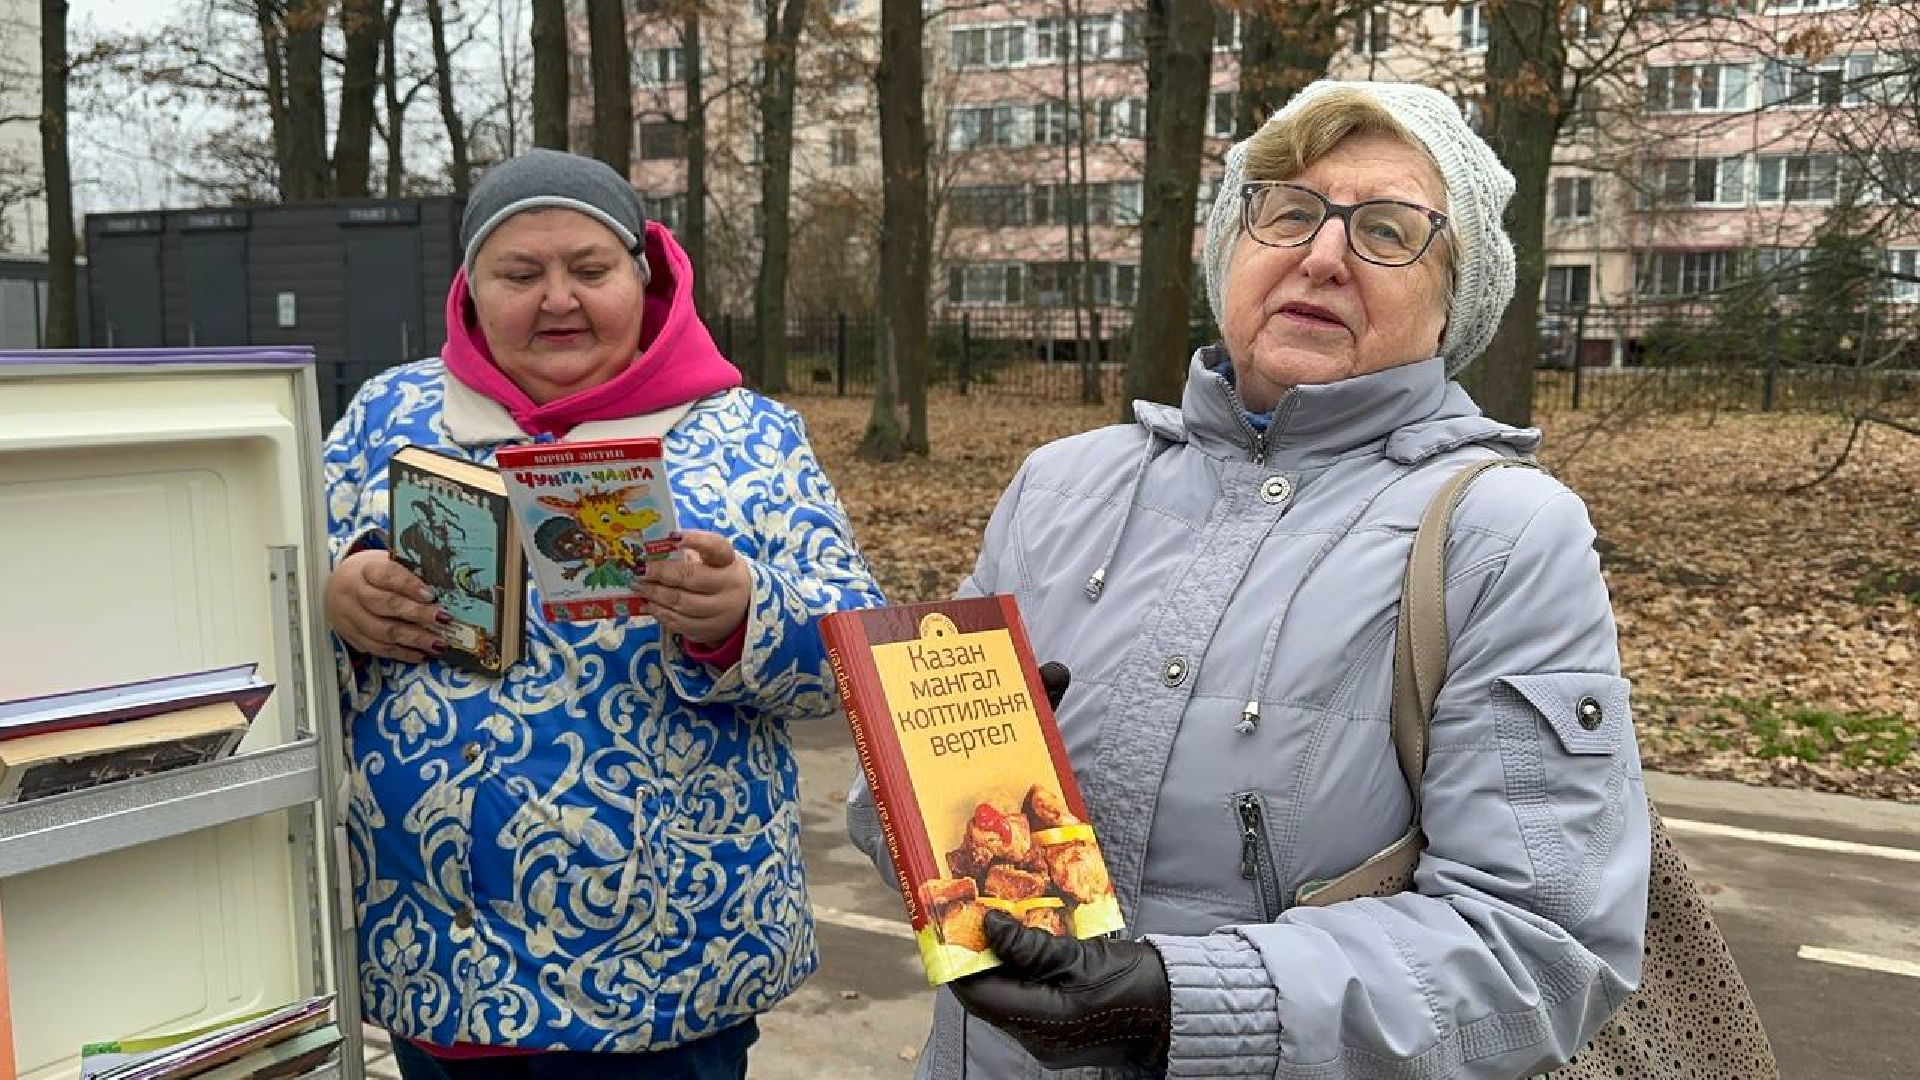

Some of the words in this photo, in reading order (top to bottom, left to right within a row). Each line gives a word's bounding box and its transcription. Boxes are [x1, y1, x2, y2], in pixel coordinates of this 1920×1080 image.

[534, 451, 575, 464] ЮРИЙ
[580, 449, 625, 462] ЭНТИН
[513, 465, 655, 489] ЧУНГА-ЧАНГА
[829, 647, 852, 700] вертел
[907, 644, 986, 673] Казан
[909, 668, 1001, 701] мангал
[897, 692, 1028, 733] коптильня
[848, 709, 880, 790] коптильня
[930, 723, 1018, 760] вертел
[876, 800, 900, 860] мангал
